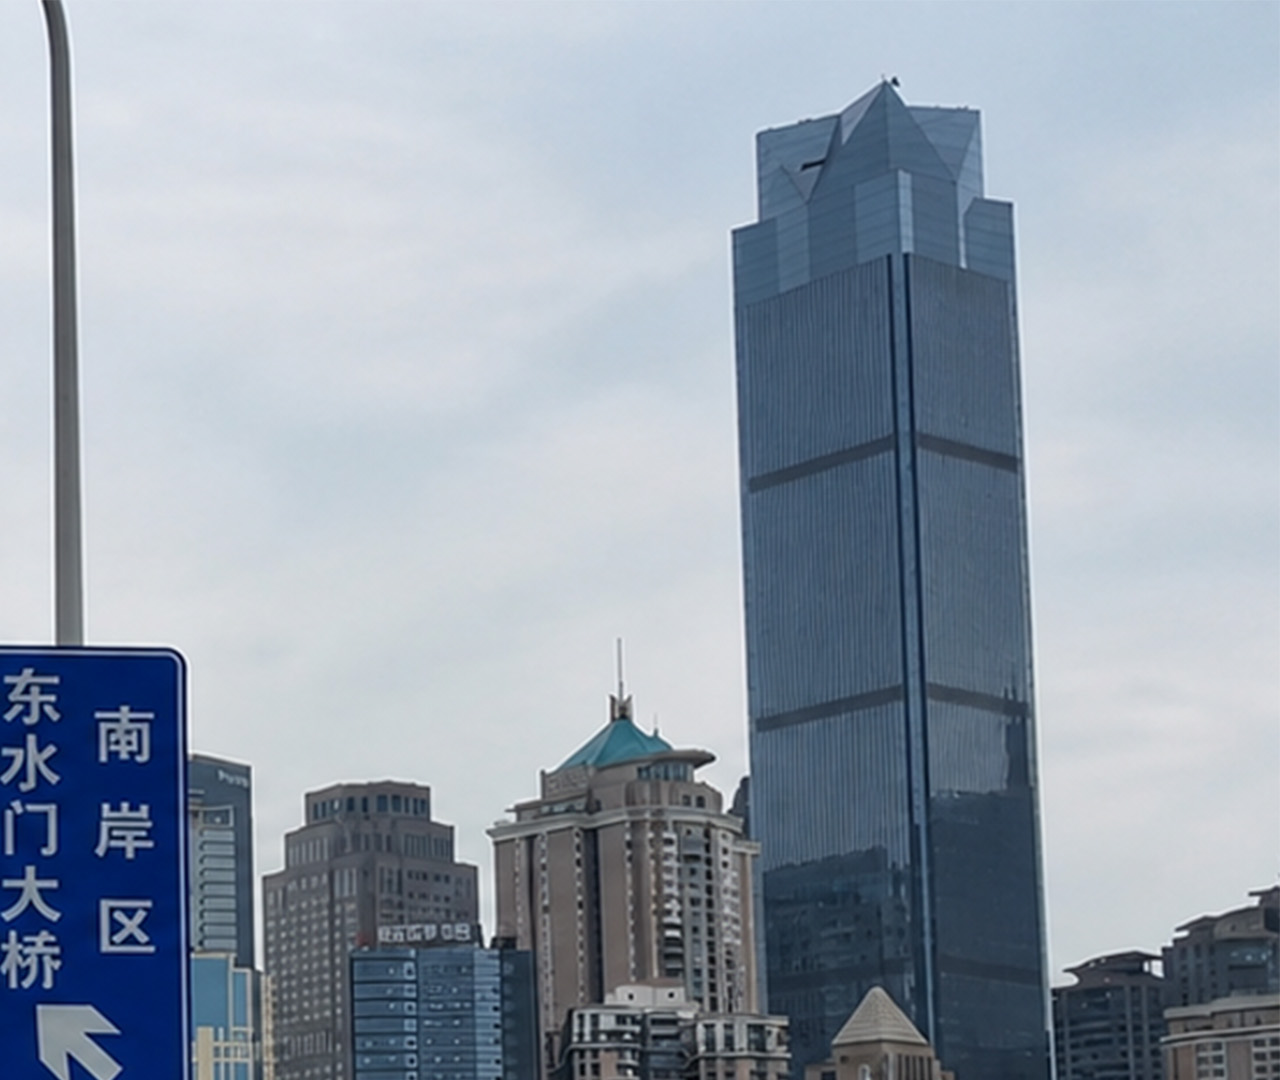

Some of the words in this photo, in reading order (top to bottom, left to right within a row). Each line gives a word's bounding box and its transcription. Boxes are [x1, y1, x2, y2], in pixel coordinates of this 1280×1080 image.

[0, 668, 62, 990] 东水门大桥
[94, 705, 156, 954] 南岸区
